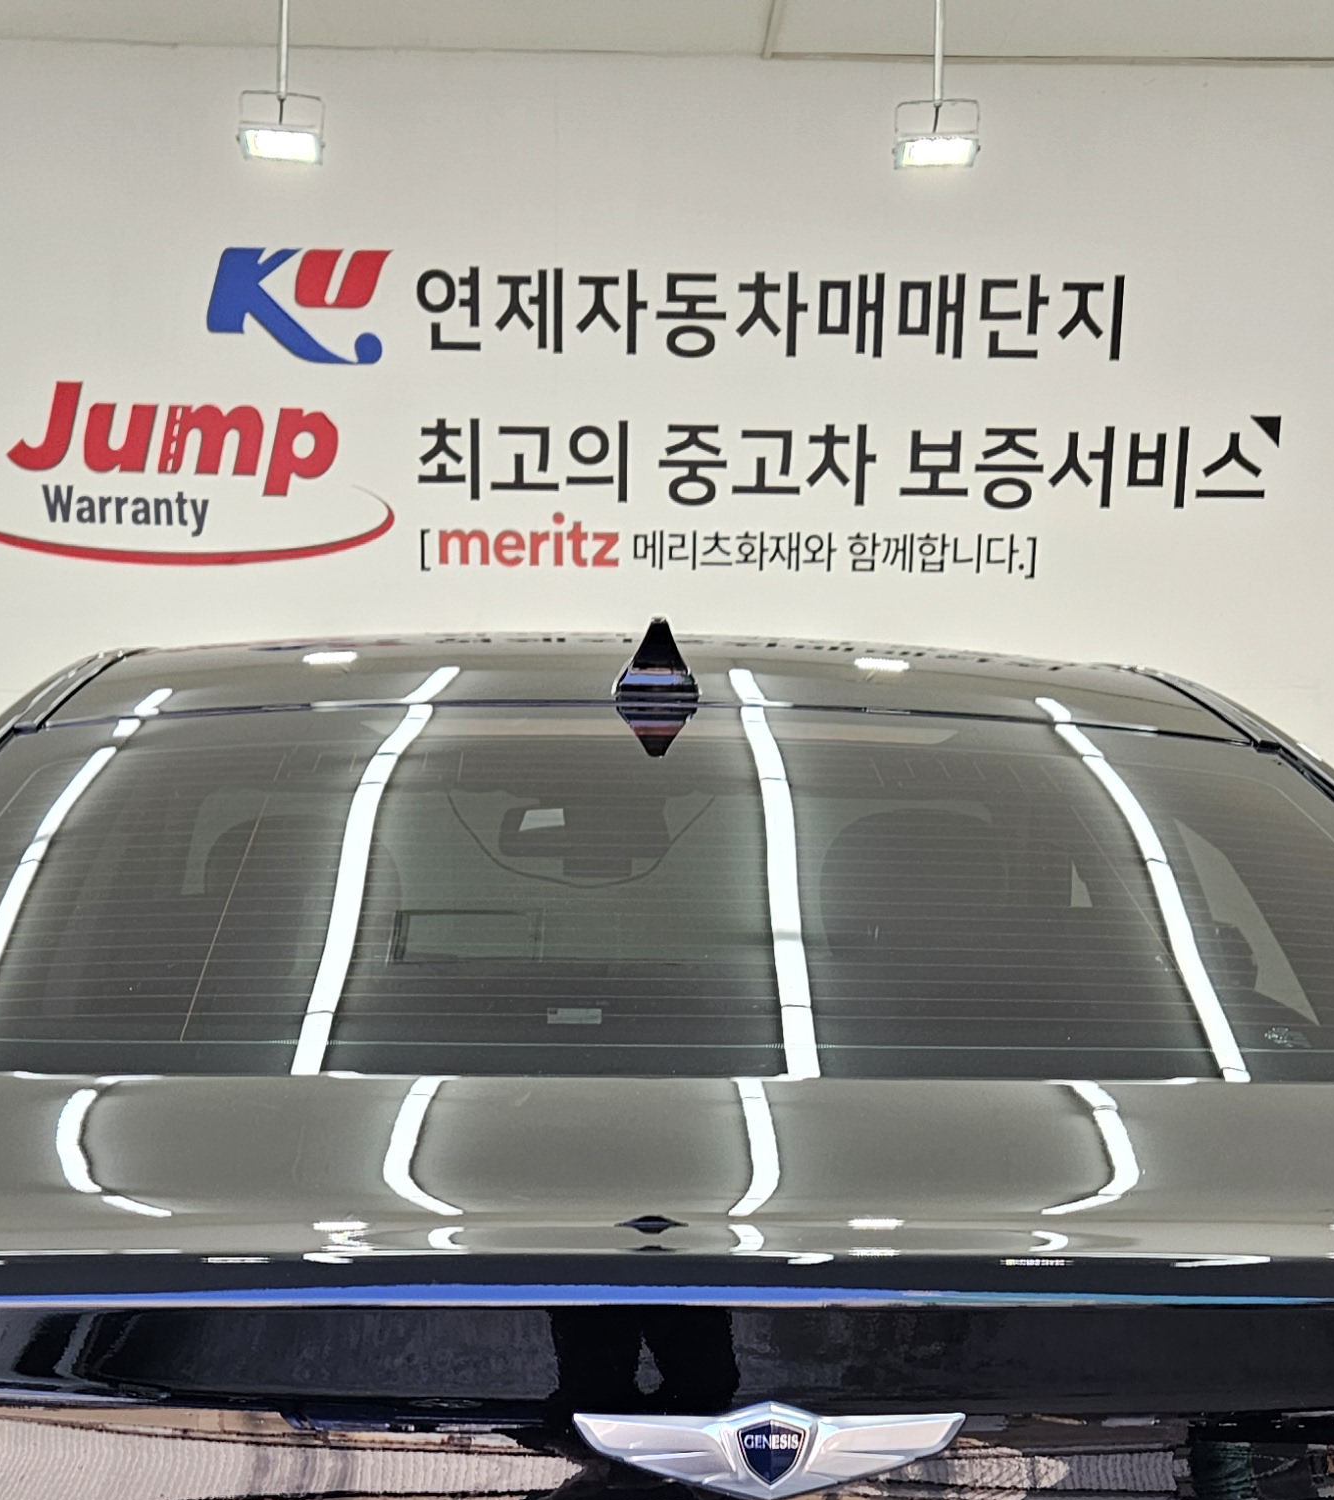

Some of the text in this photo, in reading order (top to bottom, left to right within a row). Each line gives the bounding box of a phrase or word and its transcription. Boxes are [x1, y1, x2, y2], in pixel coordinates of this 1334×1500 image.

[415, 265, 1126, 362] 연제자동차매매단지
[6, 380, 339, 498] Jump
[416, 417, 1267, 510] 최고의 중고차 보증서비스
[42, 484, 209, 537] Warranty
[633, 528, 837, 573] 메리츠화재와
[743, 1433, 800, 1450] GENESIS
